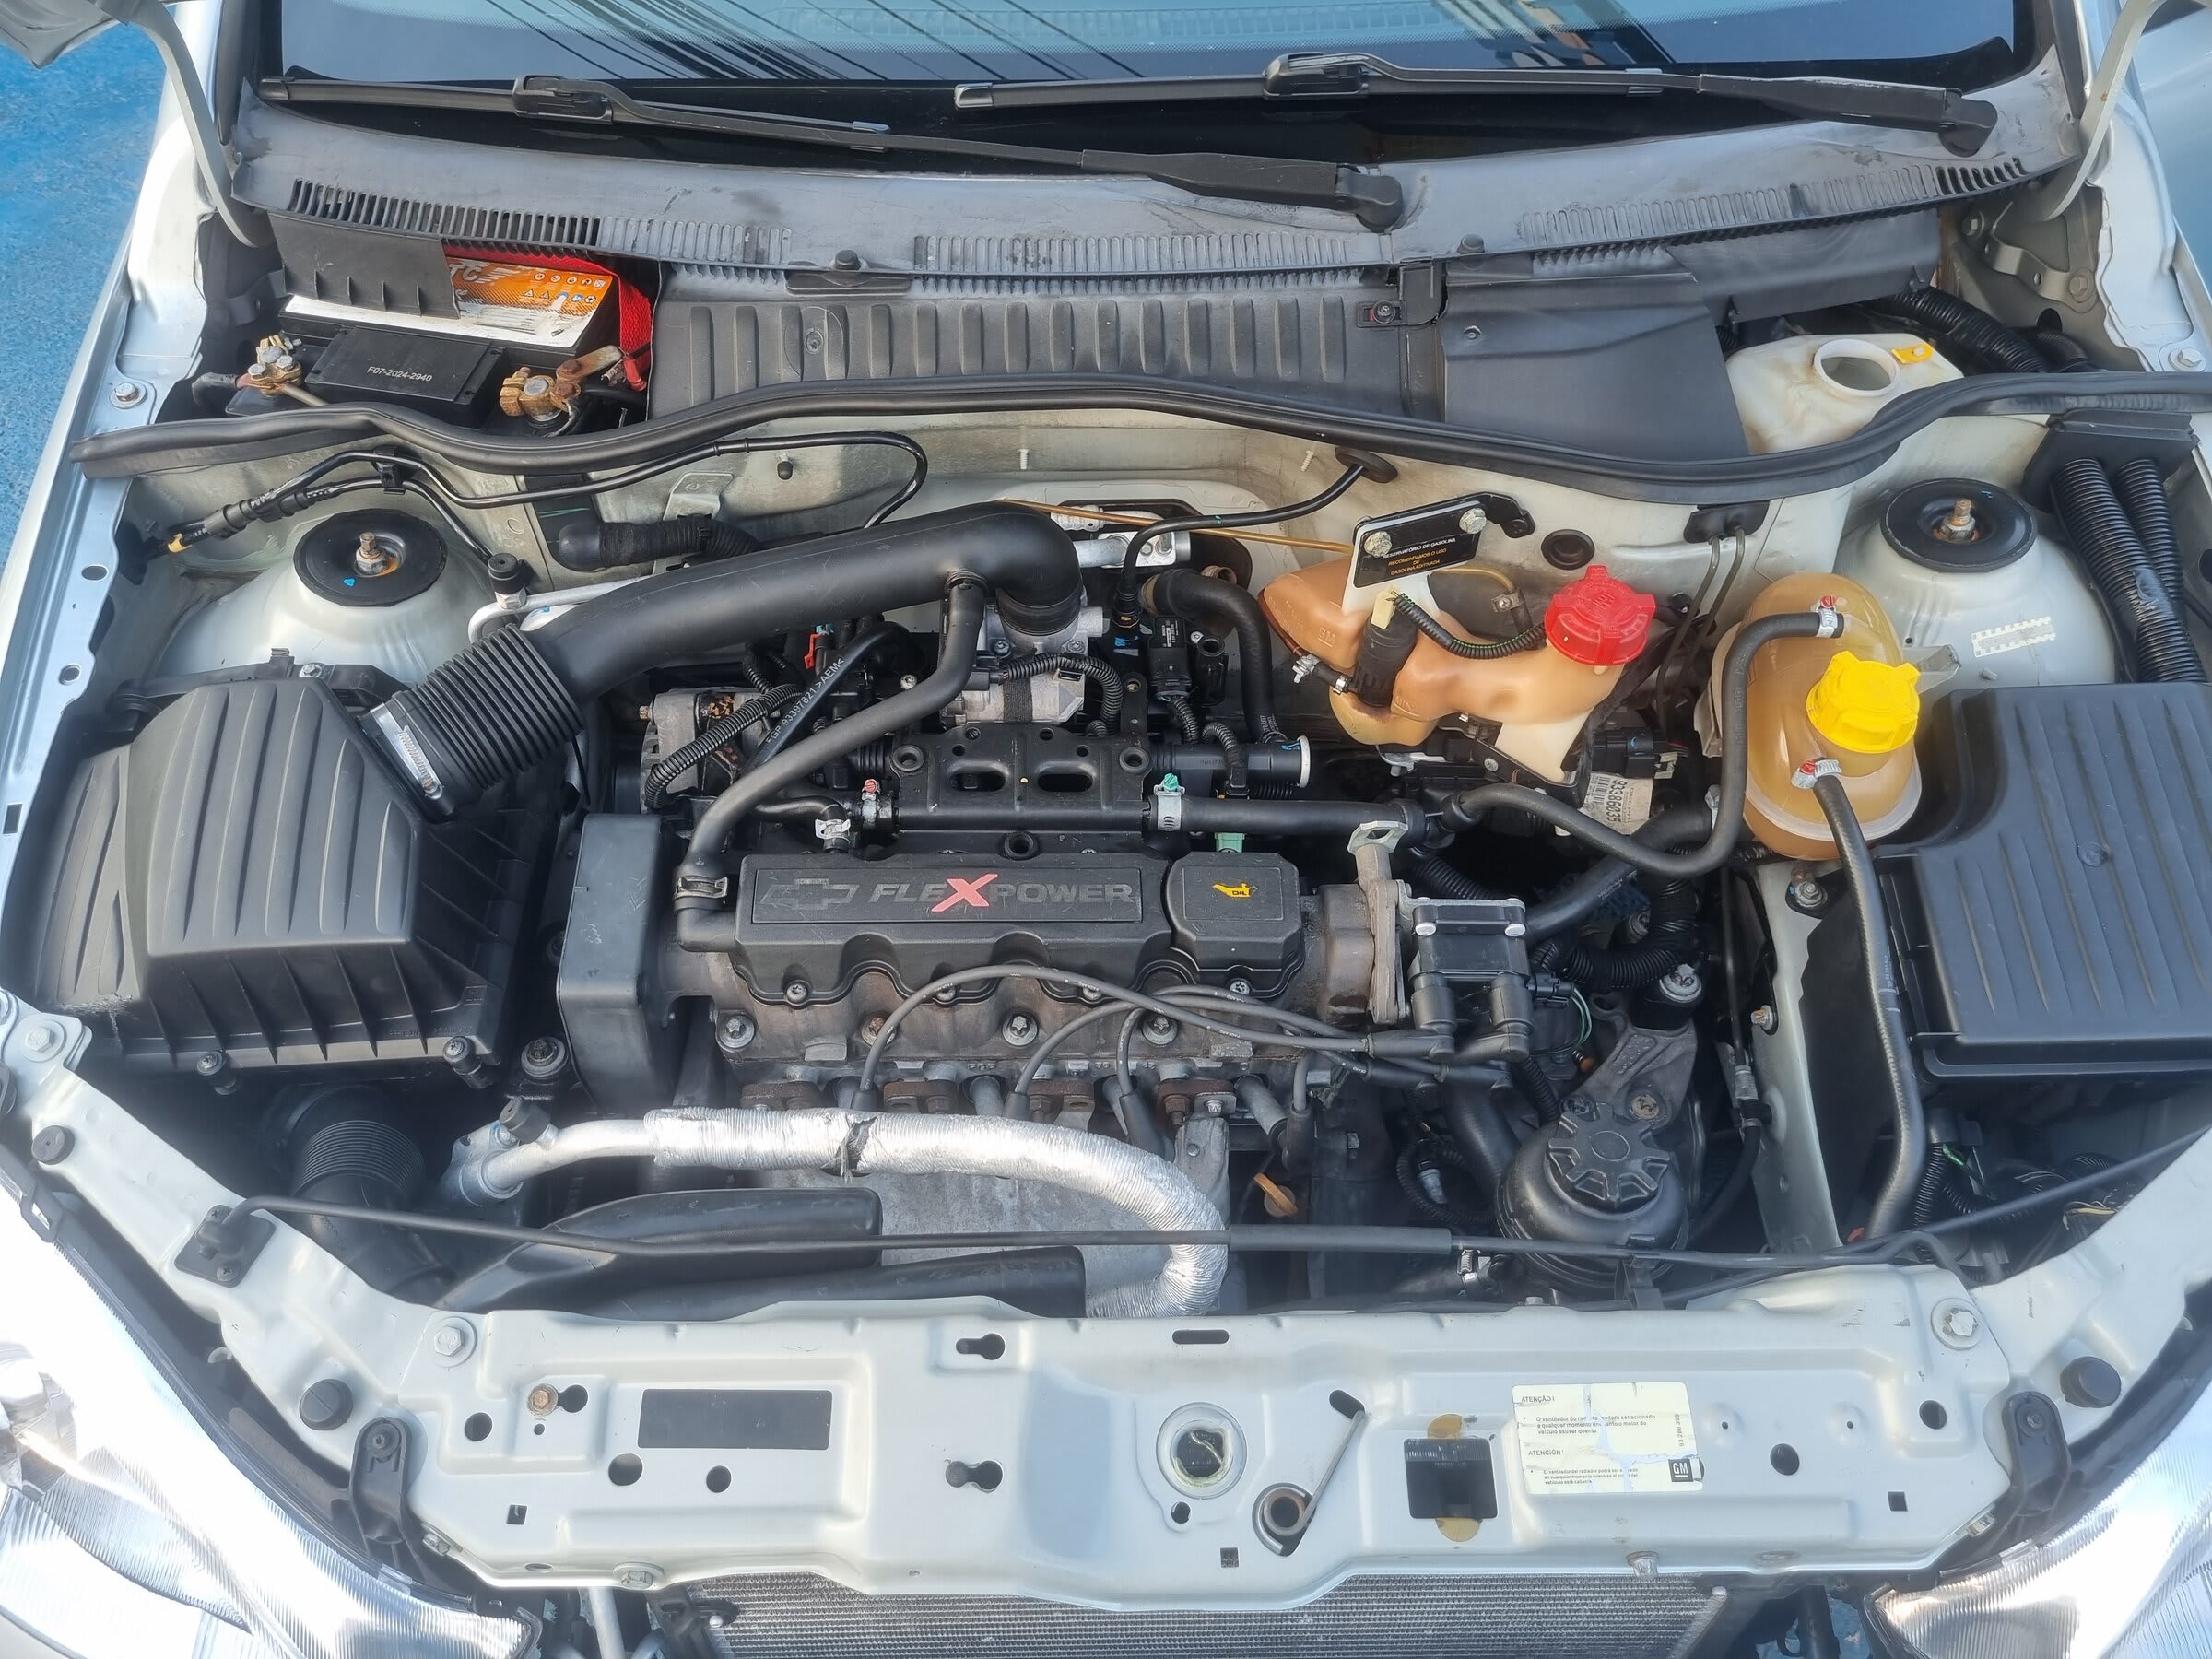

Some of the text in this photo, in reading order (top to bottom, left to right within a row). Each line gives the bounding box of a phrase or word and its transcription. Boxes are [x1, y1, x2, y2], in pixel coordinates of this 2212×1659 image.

[367, 366, 433, 382] F07-2024-2940
[1430, 538, 1456, 547] GASOLINA
[1387, 552, 1430, 565] RECOMENDAMOS
[1390, 566, 1416, 575] GASOLINA
[782, 688, 818, 726] 93397821
[815, 657, 845, 688] >AEM<
[1606, 779, 1629, 823] 93386035
[867, 873, 1135, 912] FLEXPOWER
[1672, 1462, 1689, 1475] GM
